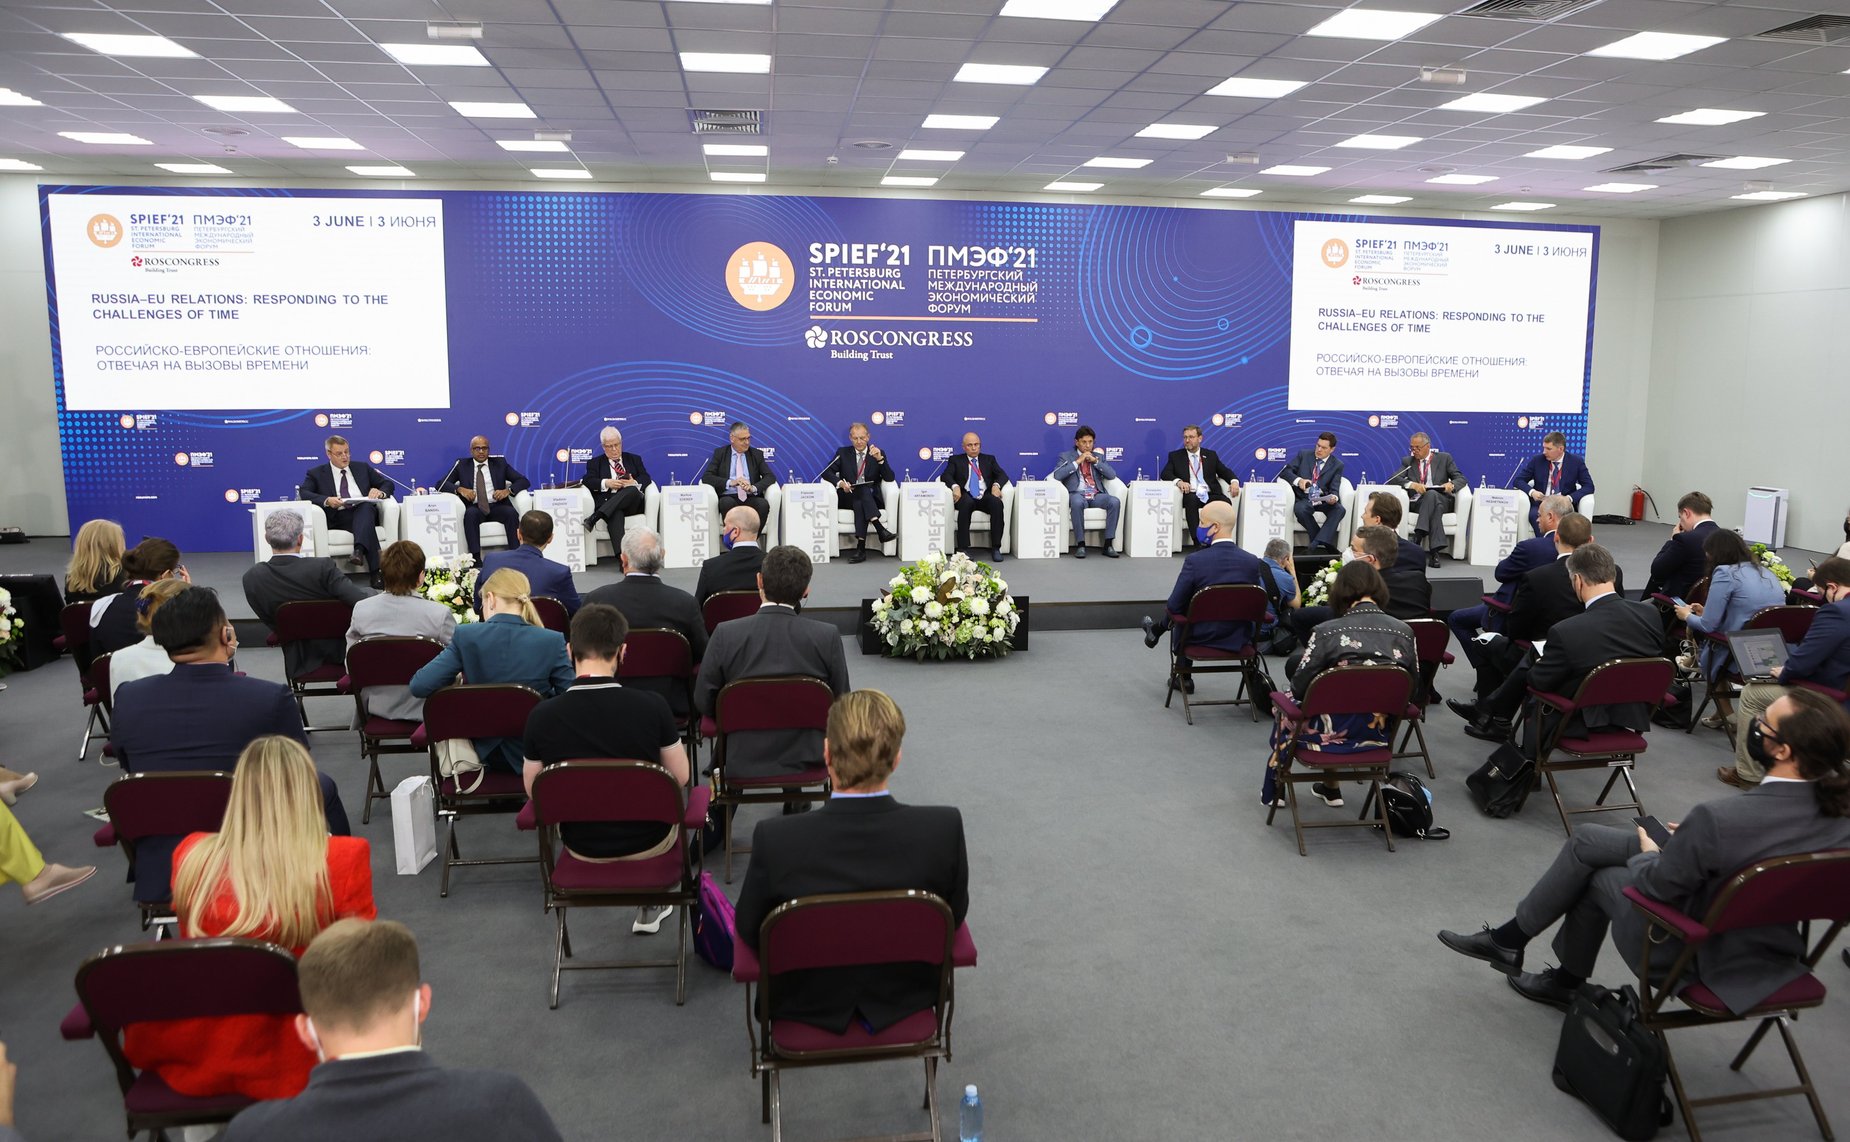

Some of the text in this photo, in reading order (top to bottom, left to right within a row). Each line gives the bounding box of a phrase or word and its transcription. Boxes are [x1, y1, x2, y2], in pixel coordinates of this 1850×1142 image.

[313, 216, 320, 226] 3
[325, 216, 364, 227] JUNE
[378, 216, 385, 227] 3
[390, 216, 436, 227] ИЮНЯ
[1495, 244, 1500, 254] 3
[1504, 245, 1533, 255] JUNE
[1543, 246, 1549, 256] 3
[1552, 247, 1587, 257] ИЮНЯ
[145, 258, 219, 266] ROSCONGRESS
[810, 267, 901, 278] ST. PETERSBURG
[929, 269, 1023, 281] ПЕТЕРБУРГСКИЙ
[810, 279, 905, 289] INTERNATIONAL
[928, 280, 1037, 293] МЕЖДУНАРОДНЫЙ
[1363, 278, 1420, 287] ROSCONGRESS
[171, 294, 247, 304] RELATIONS:
[253, 295, 336, 304] RESPONDING
[343, 295, 359, 304] TO
[364, 295, 388, 304] THE
[810, 290, 873, 300] ECONOMIC
[928, 292, 1035, 304] ЭКОНОМИЧЕСКИЙ
[810, 302, 851, 312] FORUM
[928, 304, 970, 313] ФОРУМ
[93, 309, 239, 319] CHALLENGES OF TIME
[1380, 310, 1438, 320] RELATIONS:
[1443, 312, 1506, 321] RESPONDING
[1511, 314, 1523, 322] TO
[1527, 314, 1544, 323] THE
[1318, 322, 1430, 333] CHALLENGES OF TIME
[831, 330, 972, 346] ROSCONGRESS
[96, 344, 370, 356] РОССИЙСКО-ЕВРОПЕЙСКИЕ ОТНОШЕНИЯ:
[831, 350, 893, 361] Building Trust
[97, 360, 308, 370] ОТВЕЧАЯ НА ВЫЗОВЫ ВРЕМЕНИ
[1317, 353, 1527, 366] РОССИЙСКО-ЕВРОПЕЙСКИЕ ОТНОШЕНИЯ:
[1316, 366, 1479, 378] ОТВЕЧАЯ НА ВЫЗОВЫ ВРЕМЕНИ
[928, 520, 944, 551] PIEF
[1499, 528, 1516, 560] PIEF
